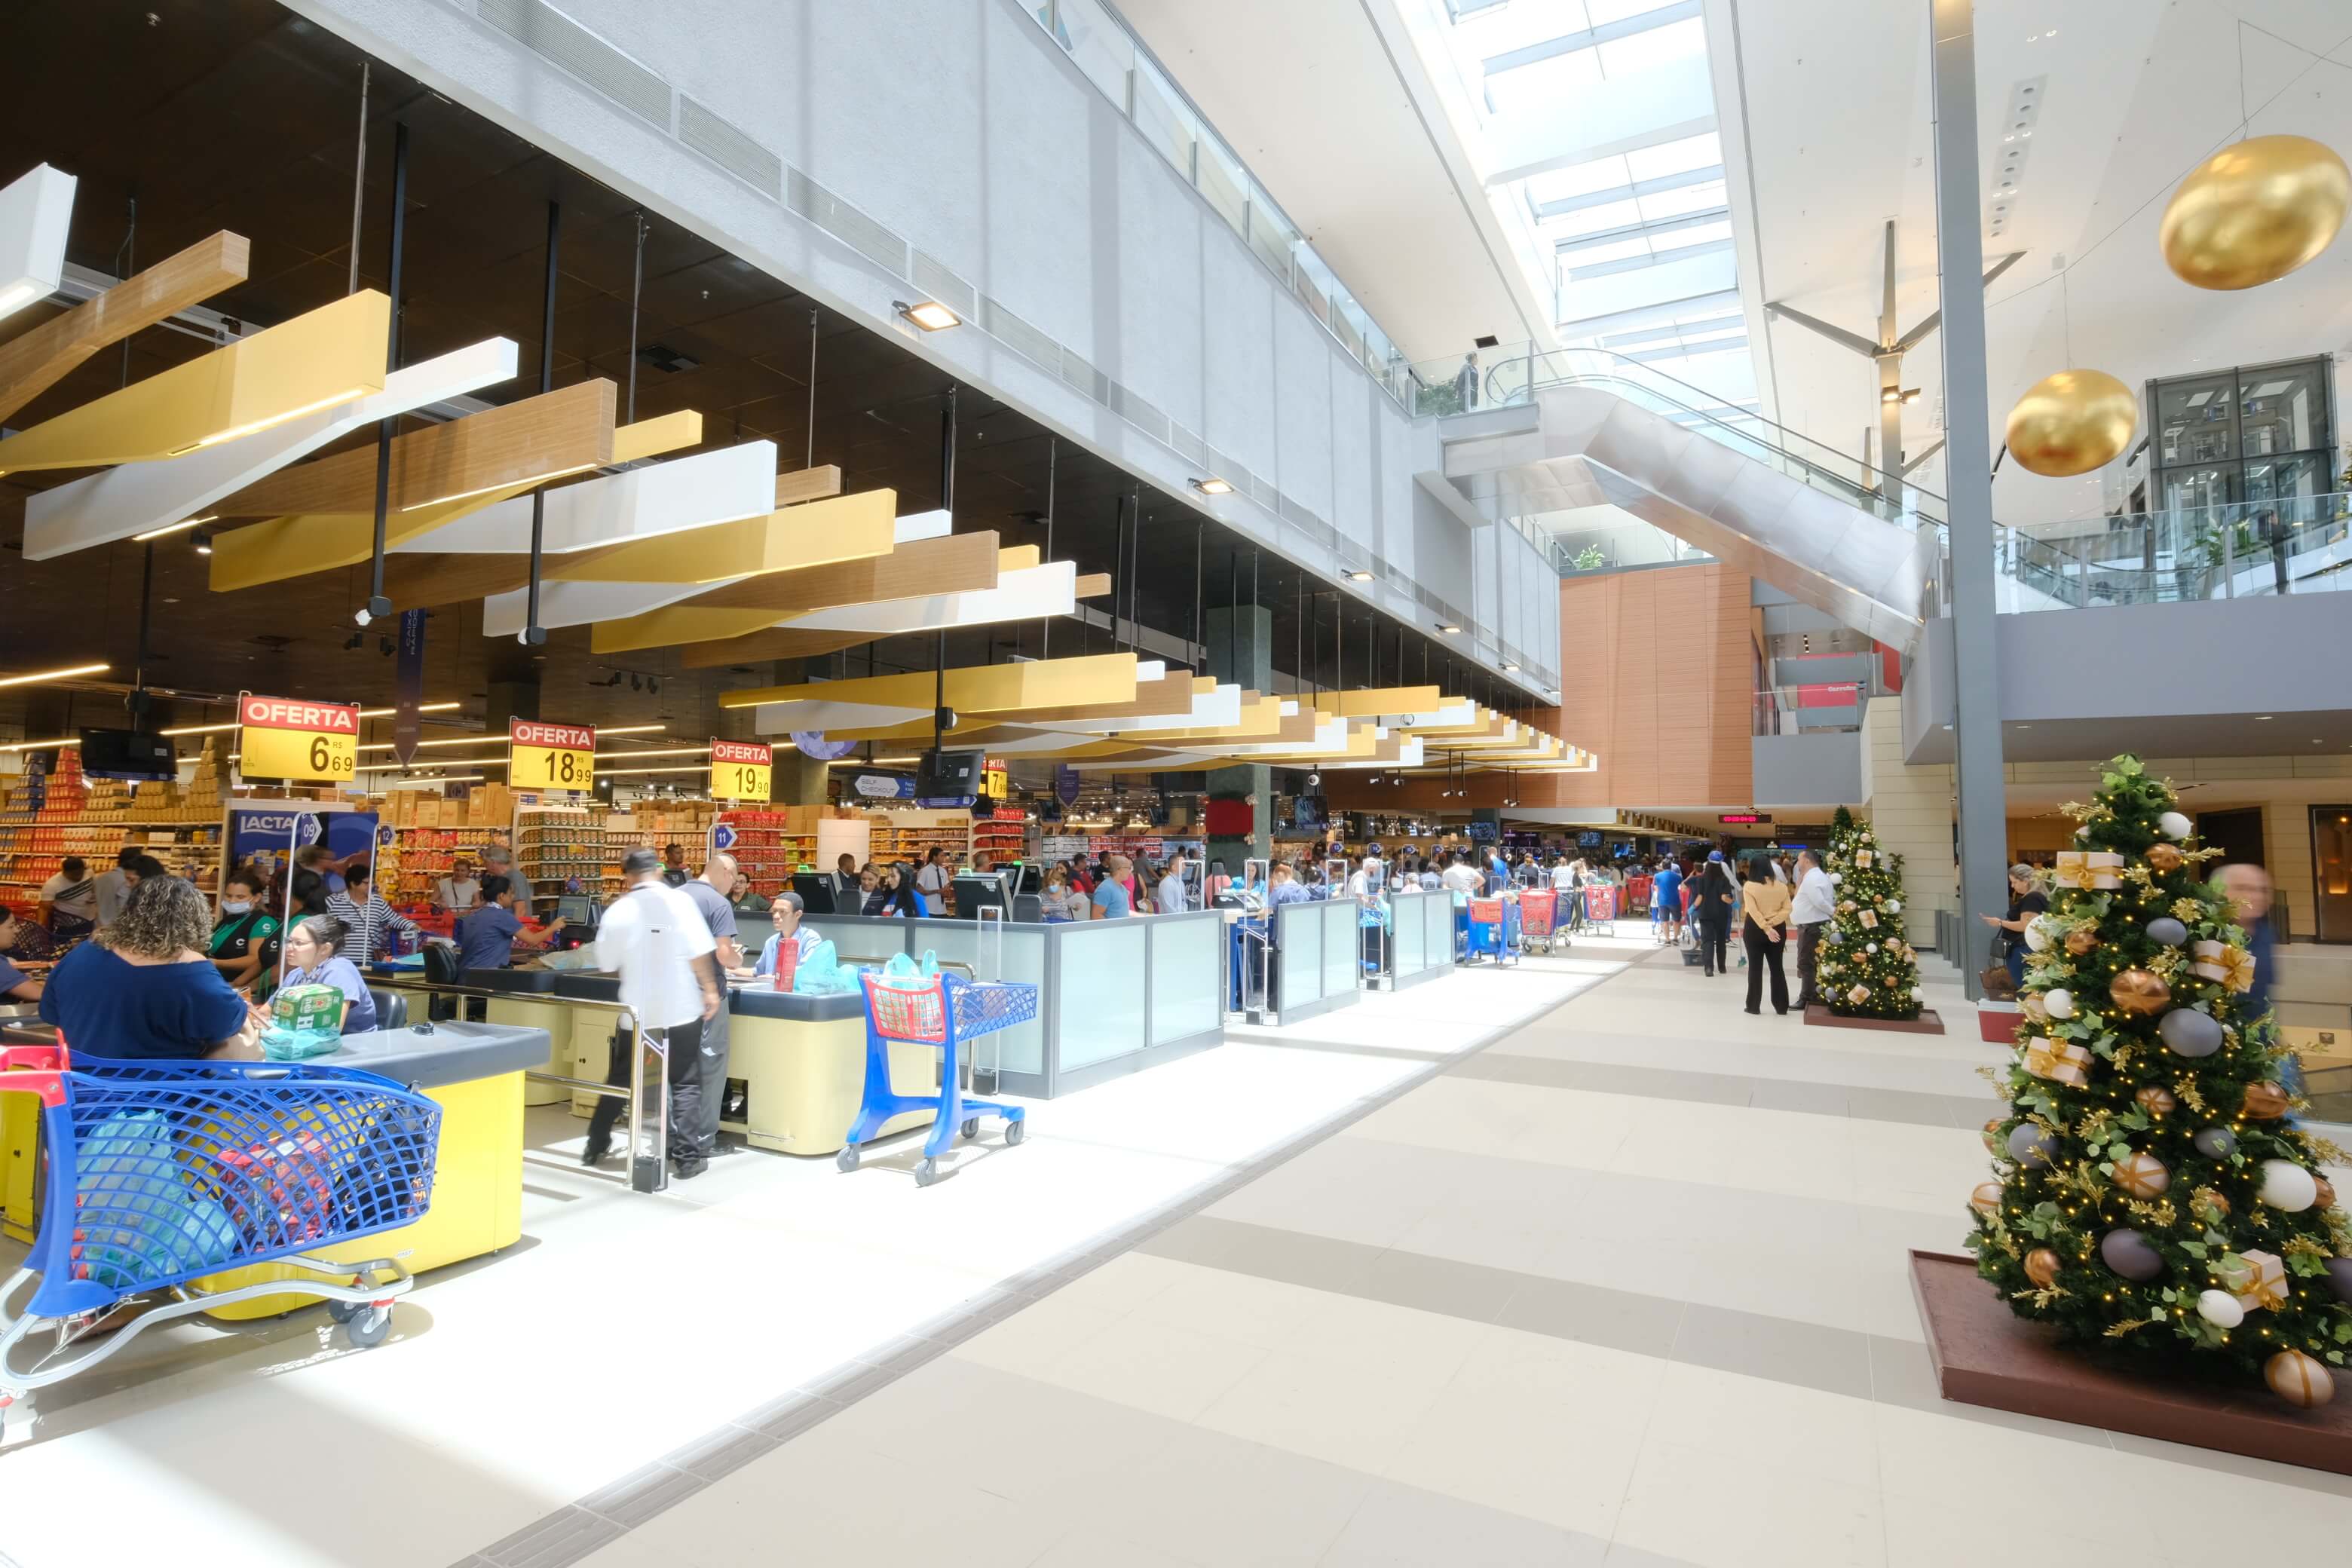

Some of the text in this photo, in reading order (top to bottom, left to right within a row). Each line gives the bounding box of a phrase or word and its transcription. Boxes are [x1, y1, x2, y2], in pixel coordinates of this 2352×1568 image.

[247, 703, 352, 728] OFERTA
[516, 725, 591, 746] OFERTA
[310, 736, 329, 772] 6
[332, 756, 353, 772] 69
[715, 744, 769, 761] OFERTA
[545, 751, 574, 782] 18
[576, 769, 591, 782] 99
[735, 767, 756, 794] 19
[758, 782, 769, 794] 90
[862, 786, 895, 795] CHECKOUT
[240, 816, 294, 832] LACTA
[303, 823, 314, 838] 09
[382, 830, 389, 841] 12
[718, 832, 727, 844] 11
